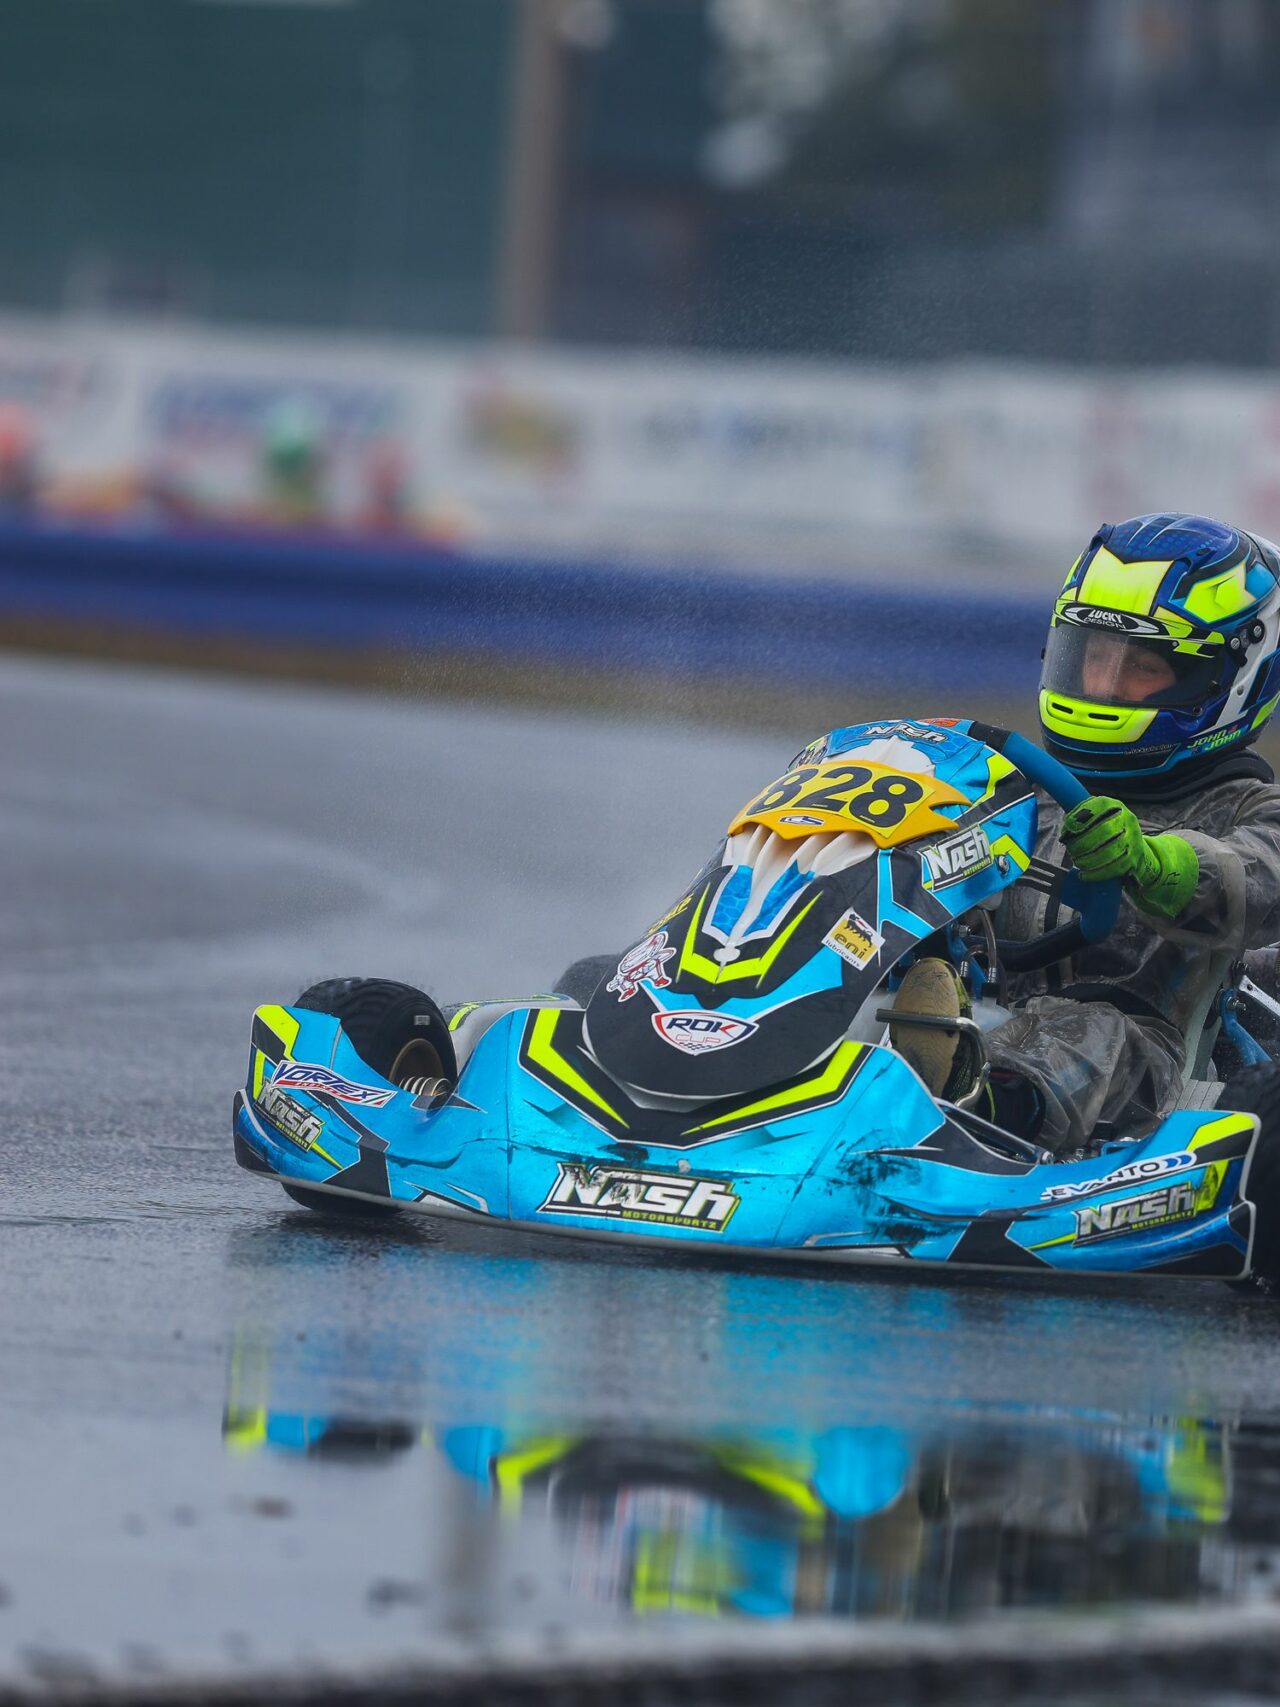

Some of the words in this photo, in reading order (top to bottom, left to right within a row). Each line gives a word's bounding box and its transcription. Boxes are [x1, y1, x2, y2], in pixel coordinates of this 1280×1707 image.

[1083, 617, 1126, 630] DESIGN
[1088, 609, 1123, 624] LUCKY
[746, 766, 924, 828] 828
[825, 939, 861, 968] lubricants
[834, 932, 868, 959] eni
[666, 1017, 738, 1039] ROK
[274, 1063, 387, 1100] VORTEX
[1050, 1162, 1160, 1196] EVANTO
